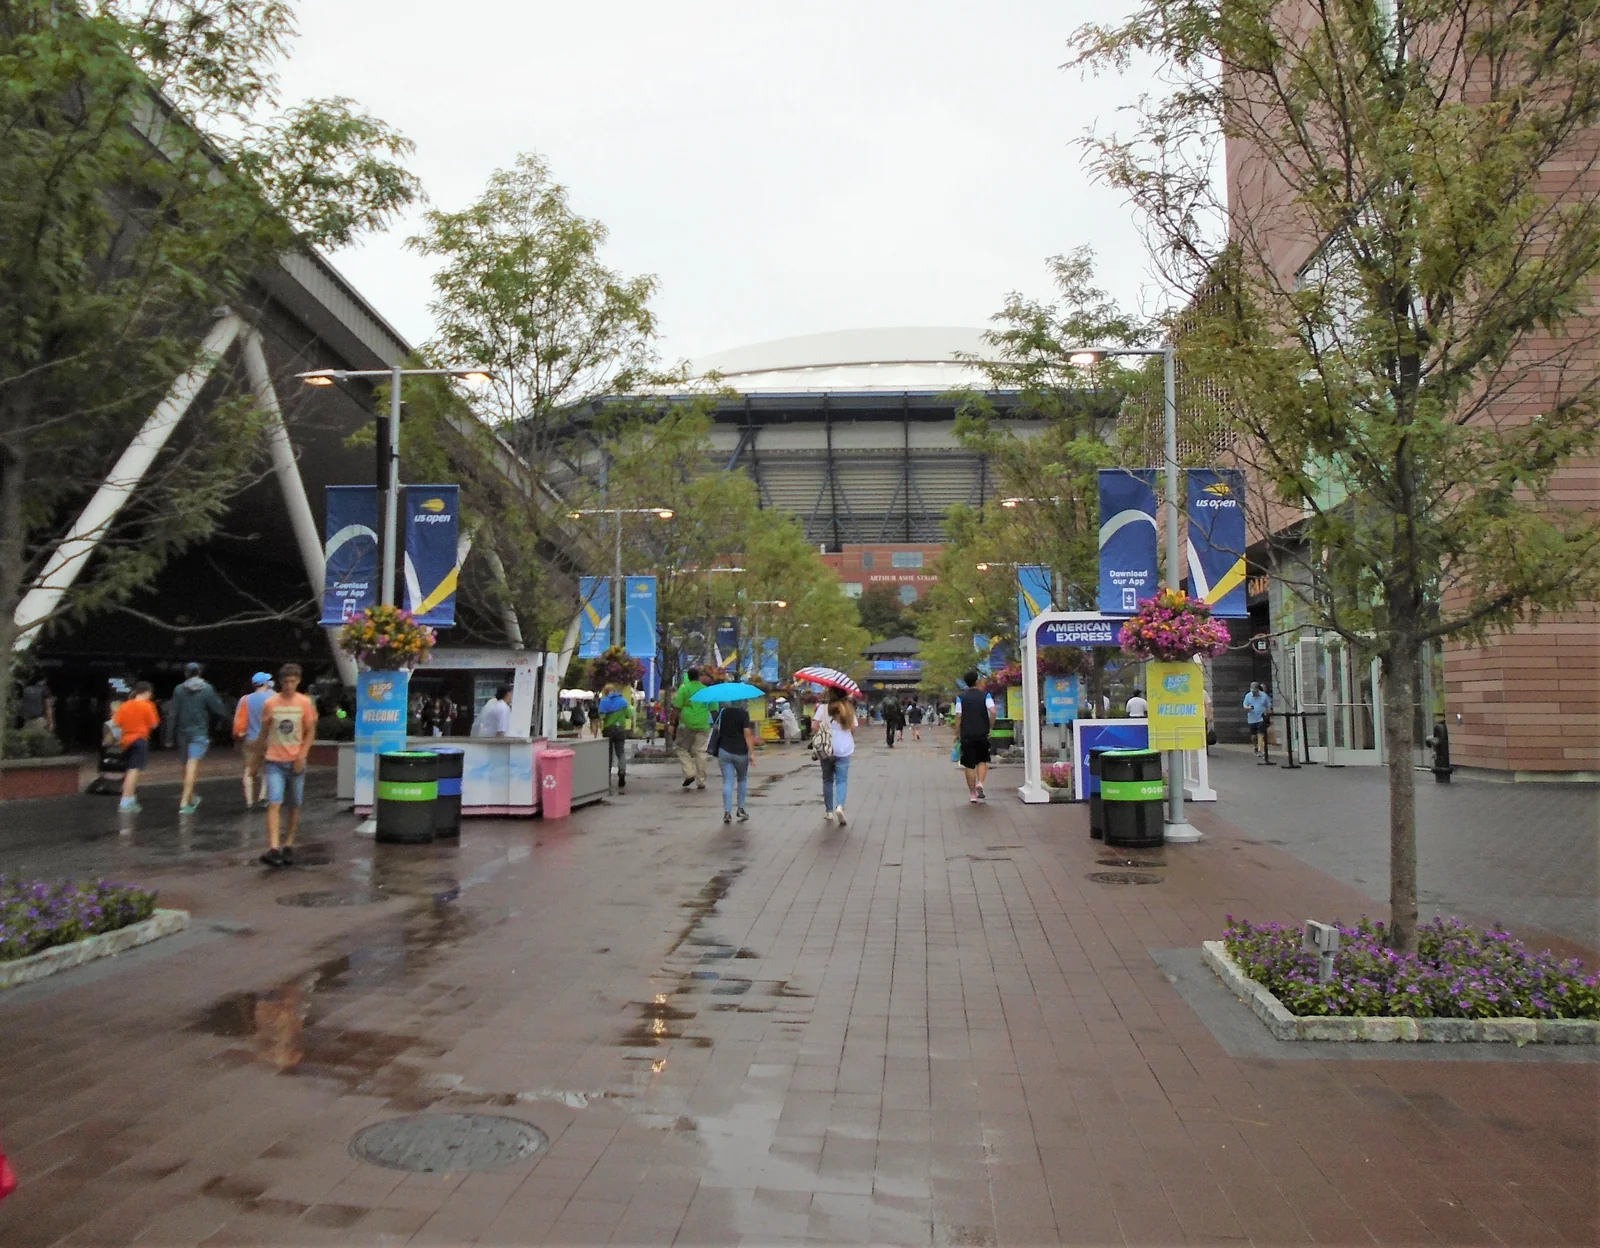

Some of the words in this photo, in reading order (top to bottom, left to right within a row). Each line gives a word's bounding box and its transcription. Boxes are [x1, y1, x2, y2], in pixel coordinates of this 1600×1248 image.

[1196, 499, 1208, 507] us
[1209, 499, 1237, 510] open
[414, 514, 426, 522] us
[426, 514, 451, 525] open
[1128, 578, 1145, 586] App
[350, 589, 365, 598] App
[1046, 622, 1112, 633] AMERICAN
[1056, 631, 1113, 642] EXPRESS
[1167, 674, 1190, 684] KIDS
[362, 709, 401, 722] WELCOME
[1157, 703, 1198, 717] WELCOME
